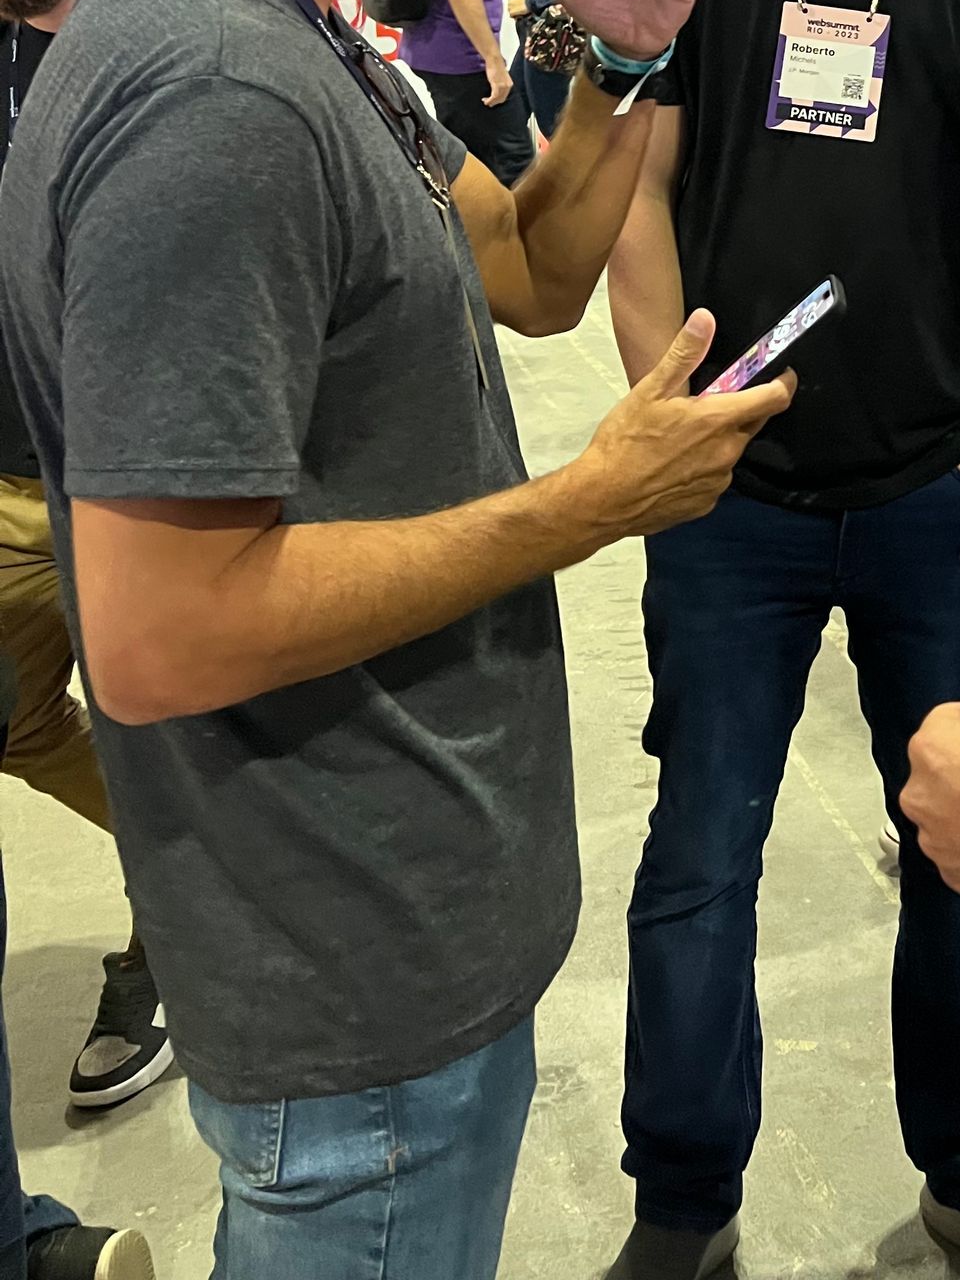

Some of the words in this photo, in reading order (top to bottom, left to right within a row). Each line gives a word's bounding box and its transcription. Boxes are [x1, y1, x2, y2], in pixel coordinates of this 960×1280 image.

[807, 19, 860, 32] websummit
[806, 27, 823, 35] RIO
[834, 30, 859, 40] 2023
[791, 42, 836, 57] Roberto
[790, 106, 853, 126] PARTNER
